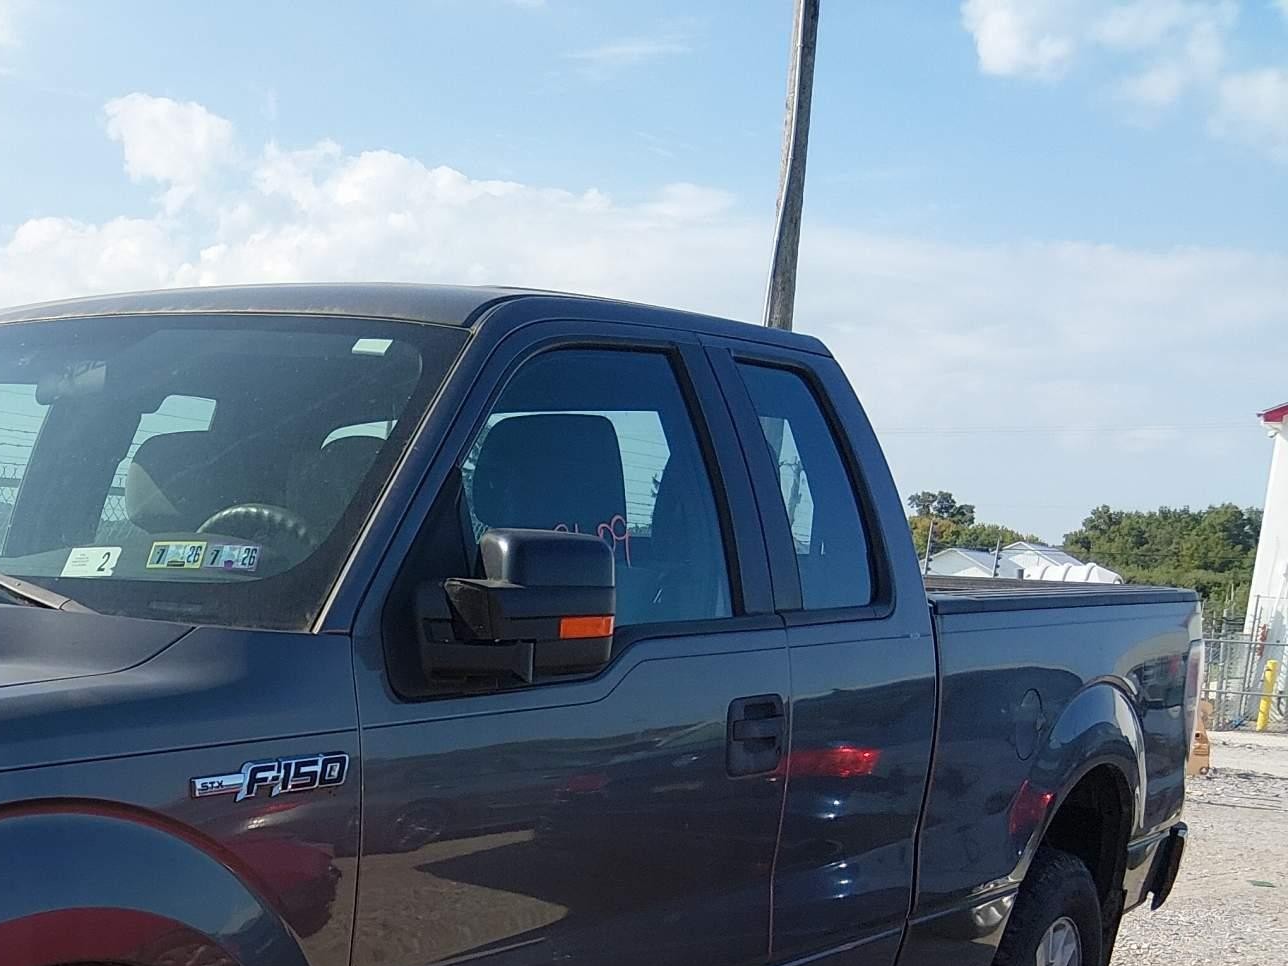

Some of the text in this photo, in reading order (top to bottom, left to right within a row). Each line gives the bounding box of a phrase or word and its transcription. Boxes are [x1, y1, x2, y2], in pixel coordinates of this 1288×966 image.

[96, 551, 111, 572] 2
[156, 545, 202, 564] 7 26
[210, 548, 257, 566] 7 26
[197, 779, 224, 791] STX
